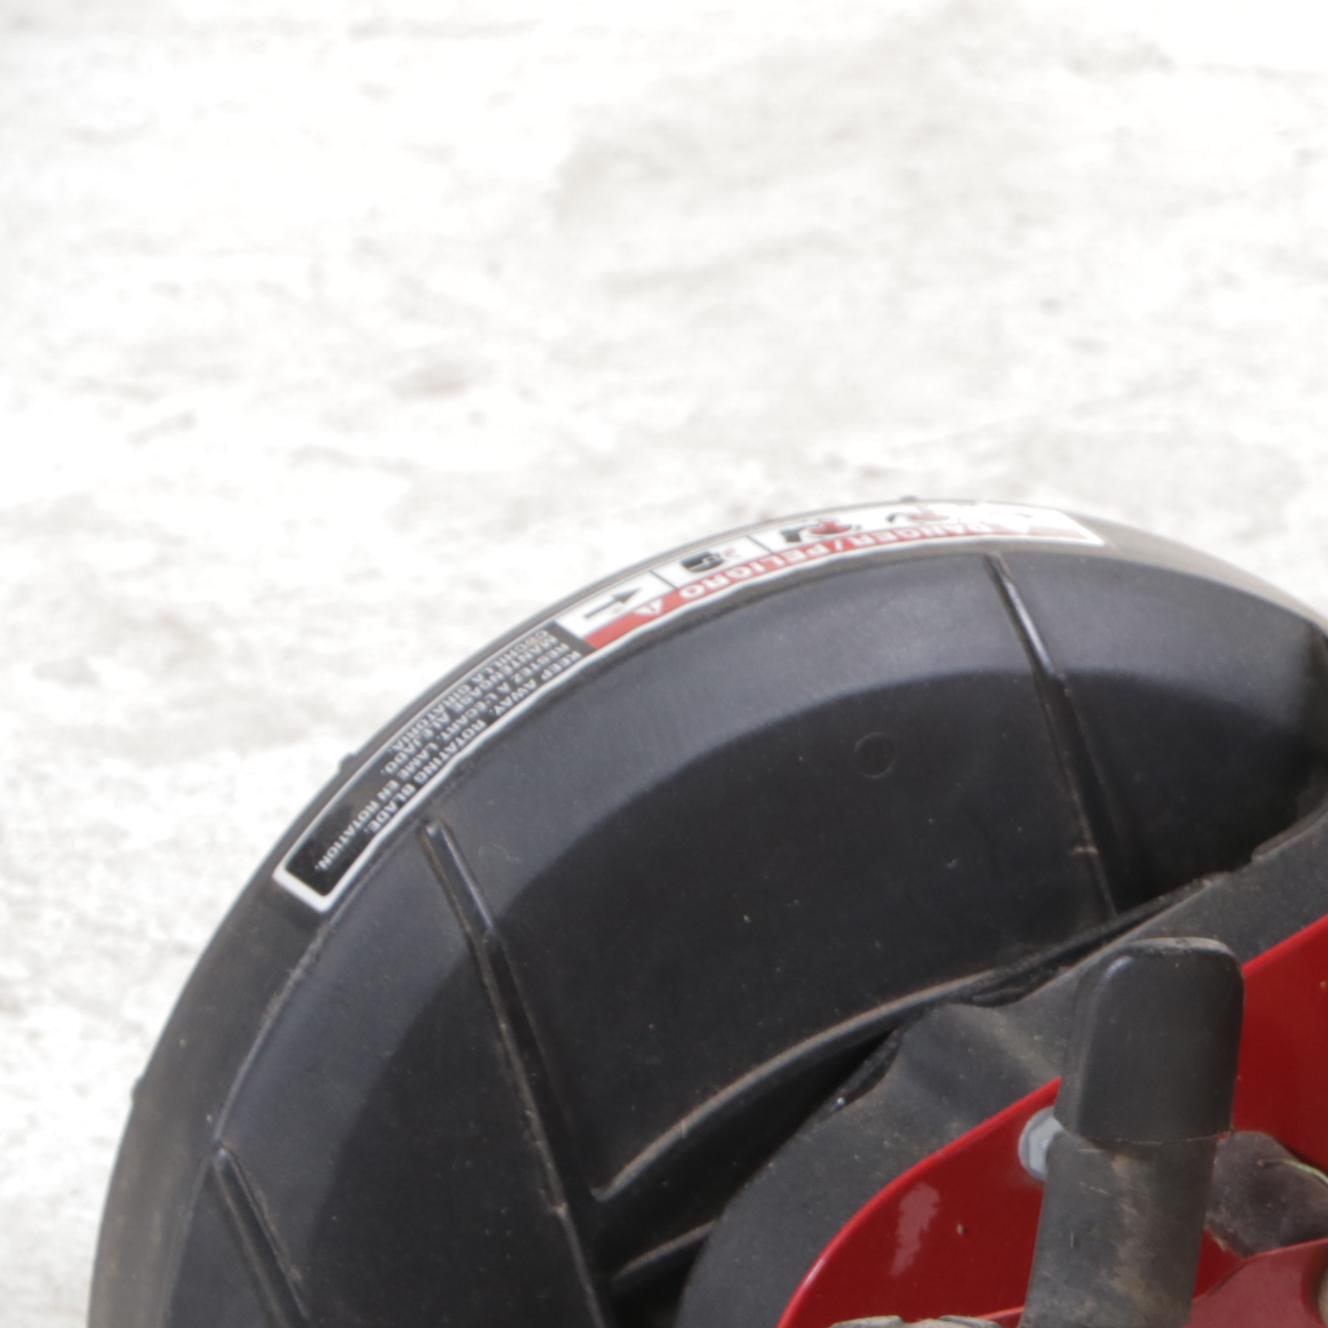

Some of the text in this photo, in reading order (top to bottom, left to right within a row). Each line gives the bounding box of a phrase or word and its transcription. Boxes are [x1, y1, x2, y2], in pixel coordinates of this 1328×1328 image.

[540, 649, 582, 682] KEEP
[413, 718, 488, 786] ROTATING
[314, 799, 380, 872] ROTATION.
[363, 783, 417, 835] BLADE.
